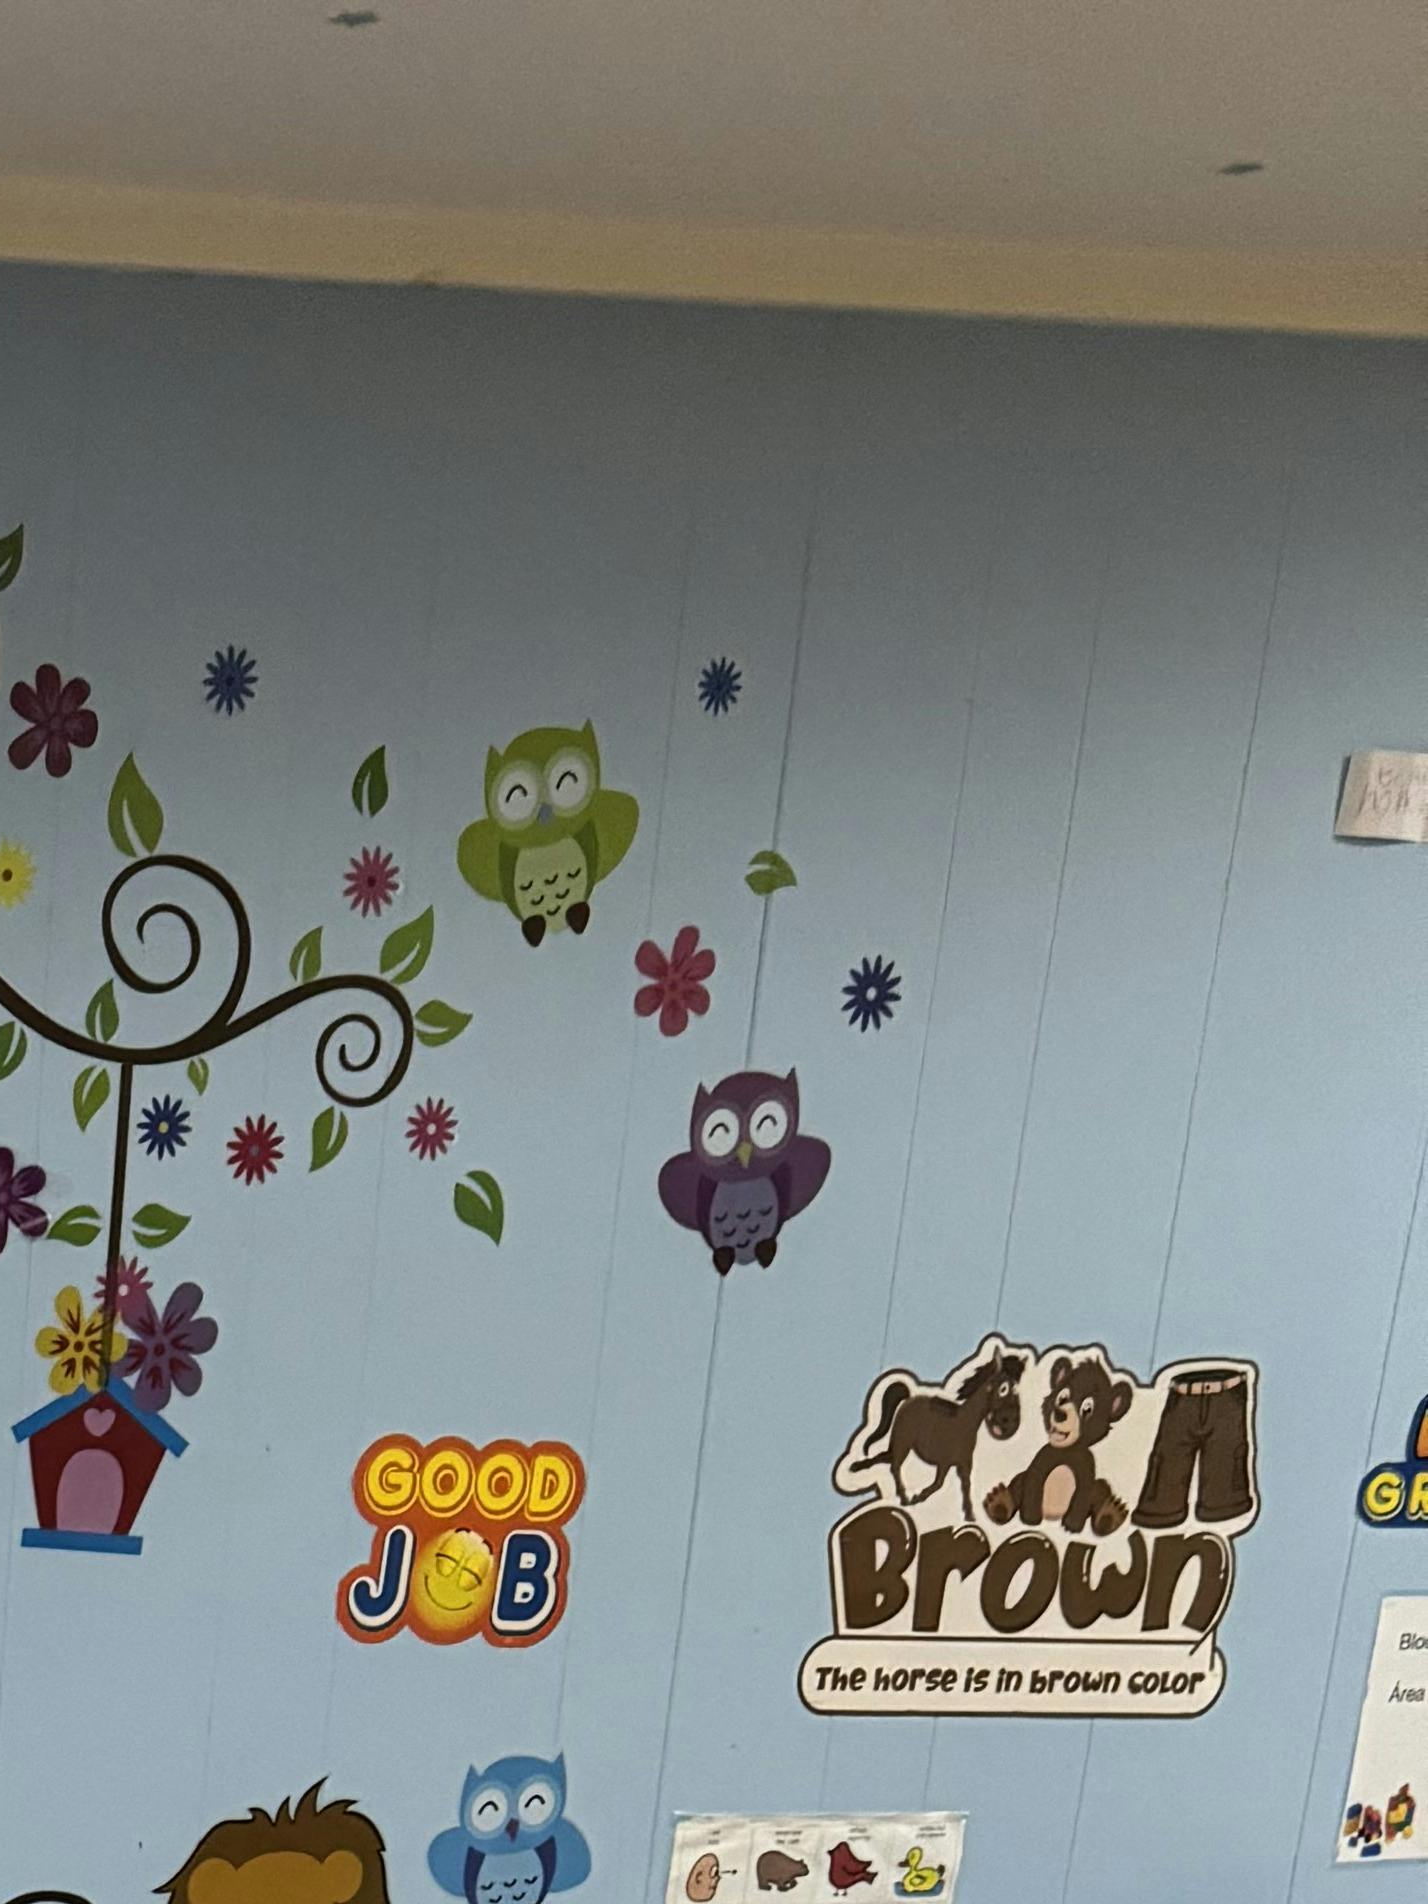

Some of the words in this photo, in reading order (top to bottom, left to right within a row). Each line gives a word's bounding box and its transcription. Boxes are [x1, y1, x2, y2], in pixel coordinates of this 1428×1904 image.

[364, 1447, 575, 1520] GOOD
[839, 1506, 1228, 1634] Brown
[815, 1667, 866, 1691] The
[873, 1667, 957, 1692] horse
[963, 1667, 990, 1692] is
[995, 1668, 1022, 1693] in
[1029, 1670, 1120, 1694] brown
[1127, 1671, 1205, 1694] color
